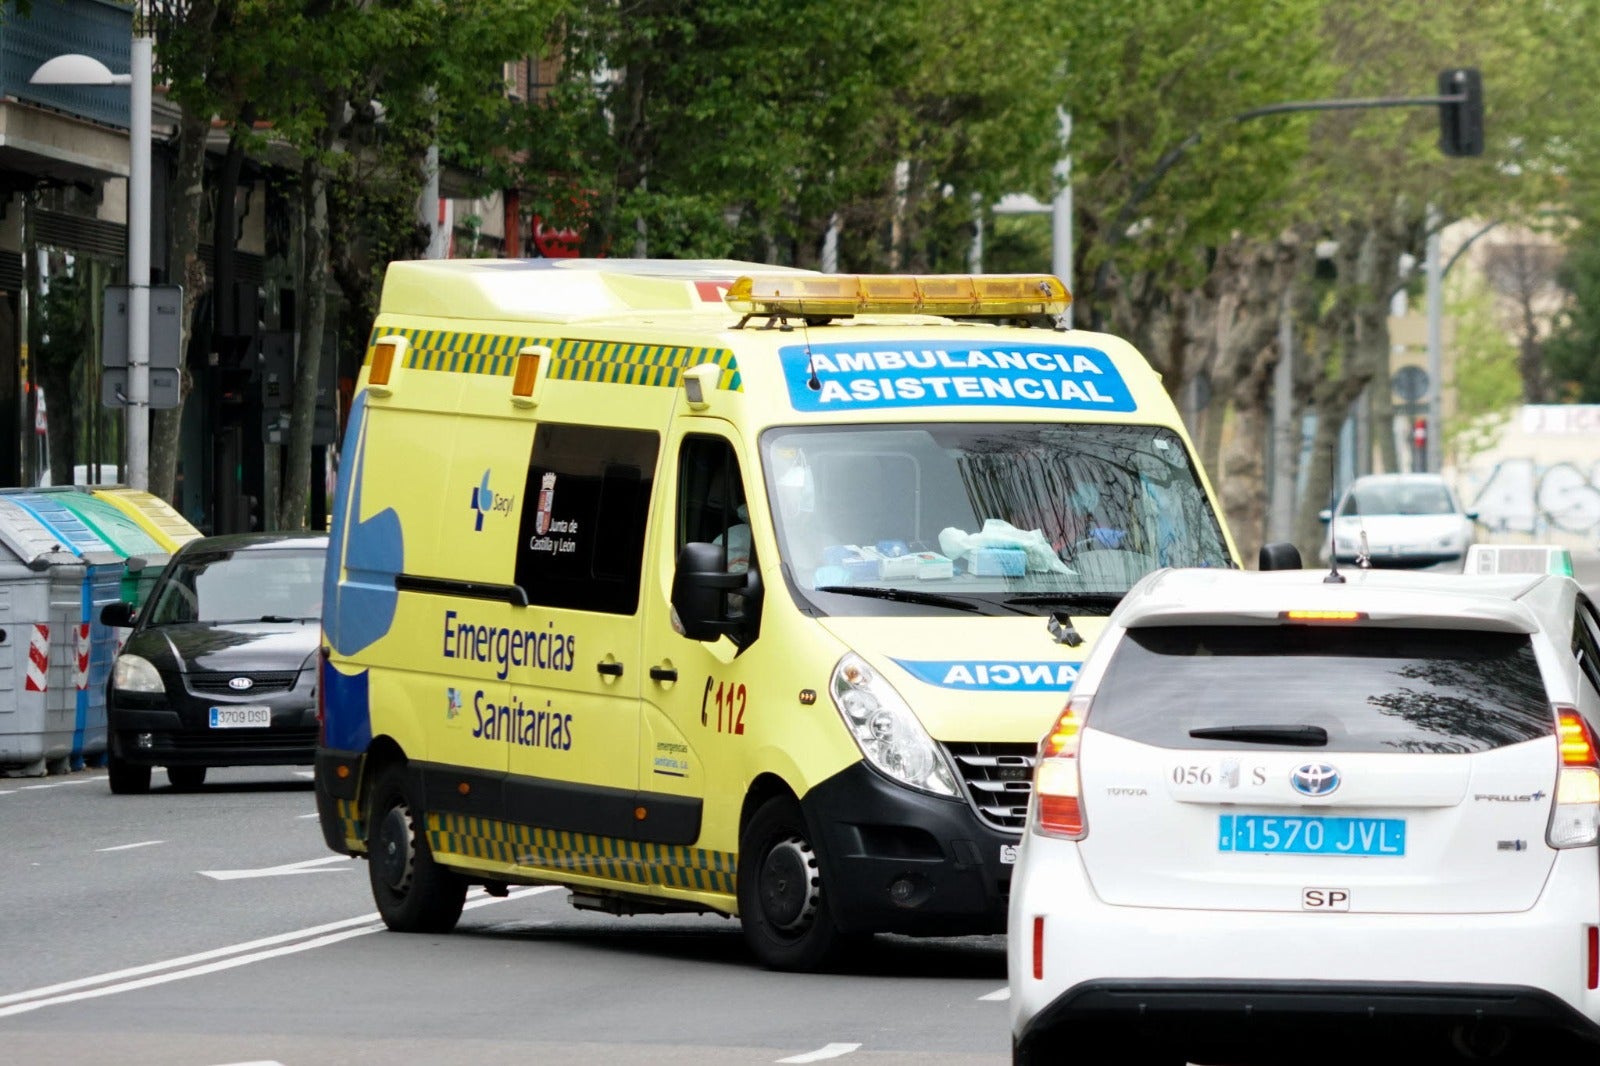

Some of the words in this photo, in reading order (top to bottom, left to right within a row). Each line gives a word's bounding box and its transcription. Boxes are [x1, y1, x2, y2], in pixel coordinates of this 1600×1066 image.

[805, 349, 1104, 375] AMBULANCIA
[818, 377, 1115, 403] ASISTENCIAL
[493, 492, 516, 517] Sacyl
[549, 517, 568, 533] Junta
[568, 518, 578, 533] de
[530, 535, 553, 551] Castilla
[552, 540, 560, 555] y
[559, 537, 576, 552] León
[443, 610, 575, 680] Emergencias
[219, 711, 246, 724] 3709
[715, 680, 747, 735] 112
[472, 690, 573, 751] Sanitarias
[1172, 766, 1213, 785] 056
[1252, 766, 1267, 786] S
[1106, 787, 1149, 797] TOYOTA
[1246, 819, 1325, 851] 1570
[1336, 821, 1398, 852] JVL
[1305, 890, 1348, 907] SP
